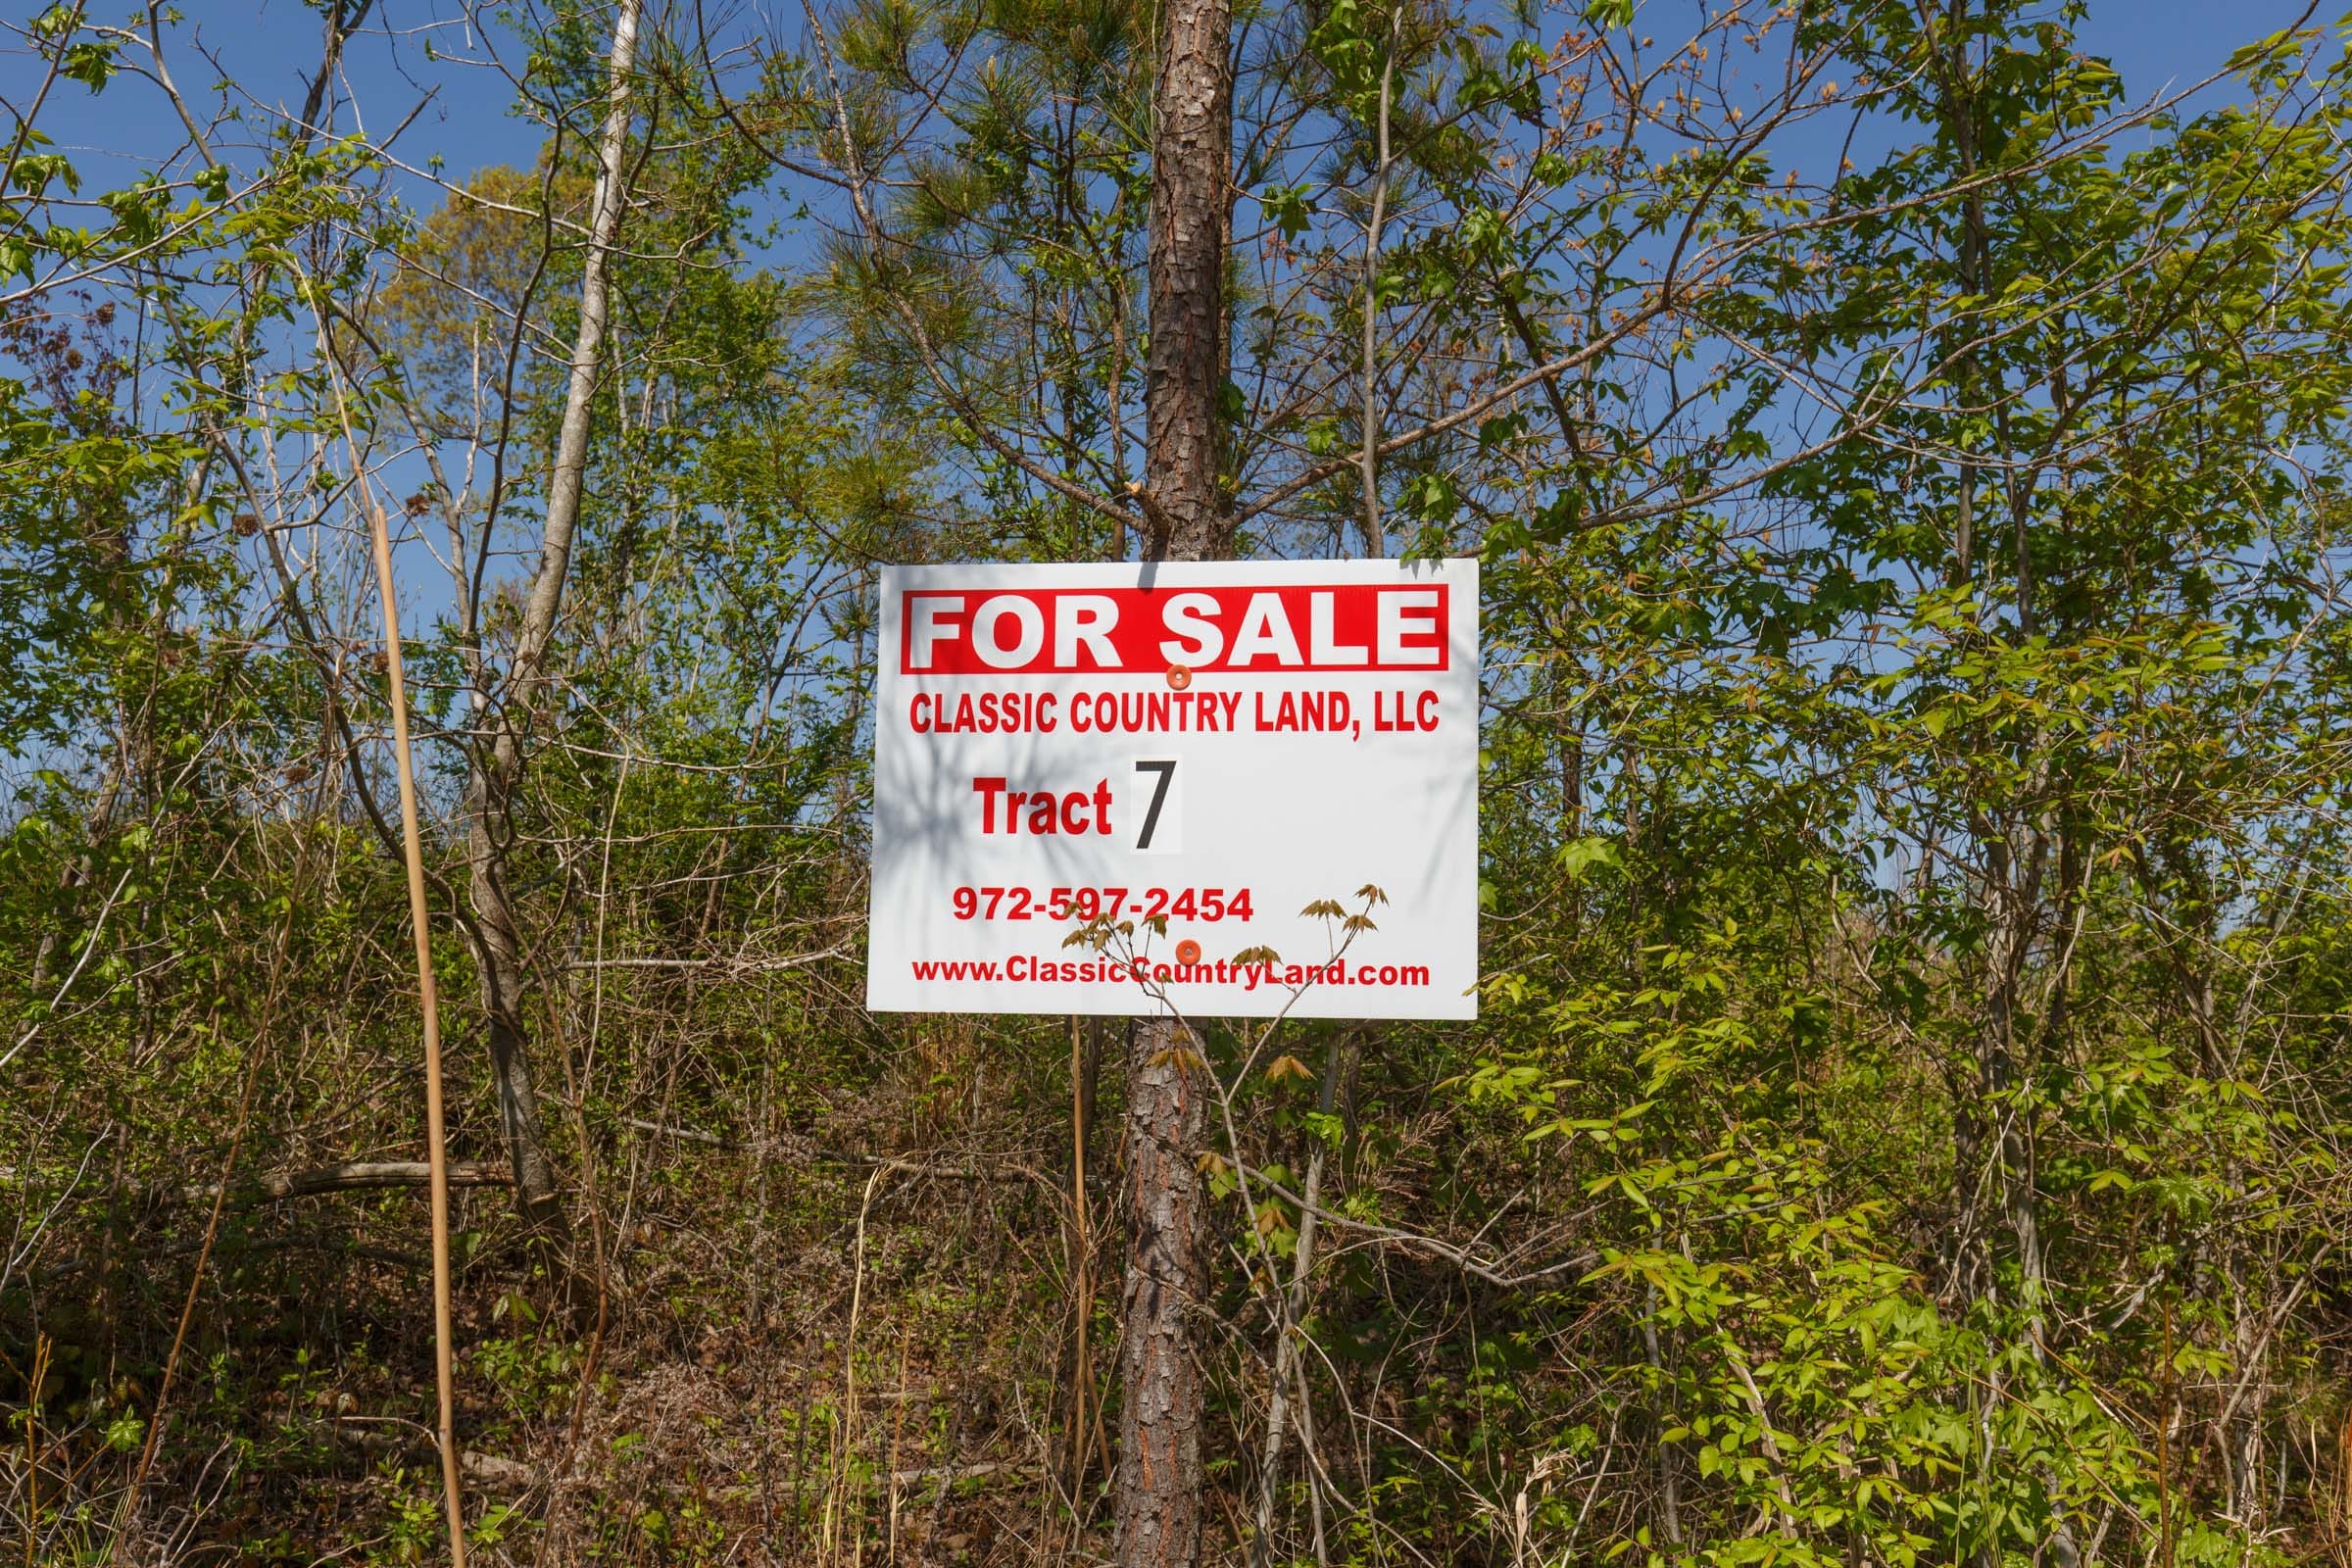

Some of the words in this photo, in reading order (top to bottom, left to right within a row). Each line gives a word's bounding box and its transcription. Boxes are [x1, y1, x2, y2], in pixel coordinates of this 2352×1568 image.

[908, 594, 1123, 668] FOR
[1158, 591, 1441, 668] SALE
[909, 691, 1057, 733] CLASSIC
[1070, 690, 1242, 733] COUNTRY
[1254, 690, 1361, 742] LAND,
[1374, 689, 1440, 732] LLC
[973, 776, 1112, 835] Tract
[1135, 760, 1178, 850] 7
[953, 886, 1254, 922] 972-597-2454
[911, 955, 1430, 991] www.ClassicCountryLand.com
